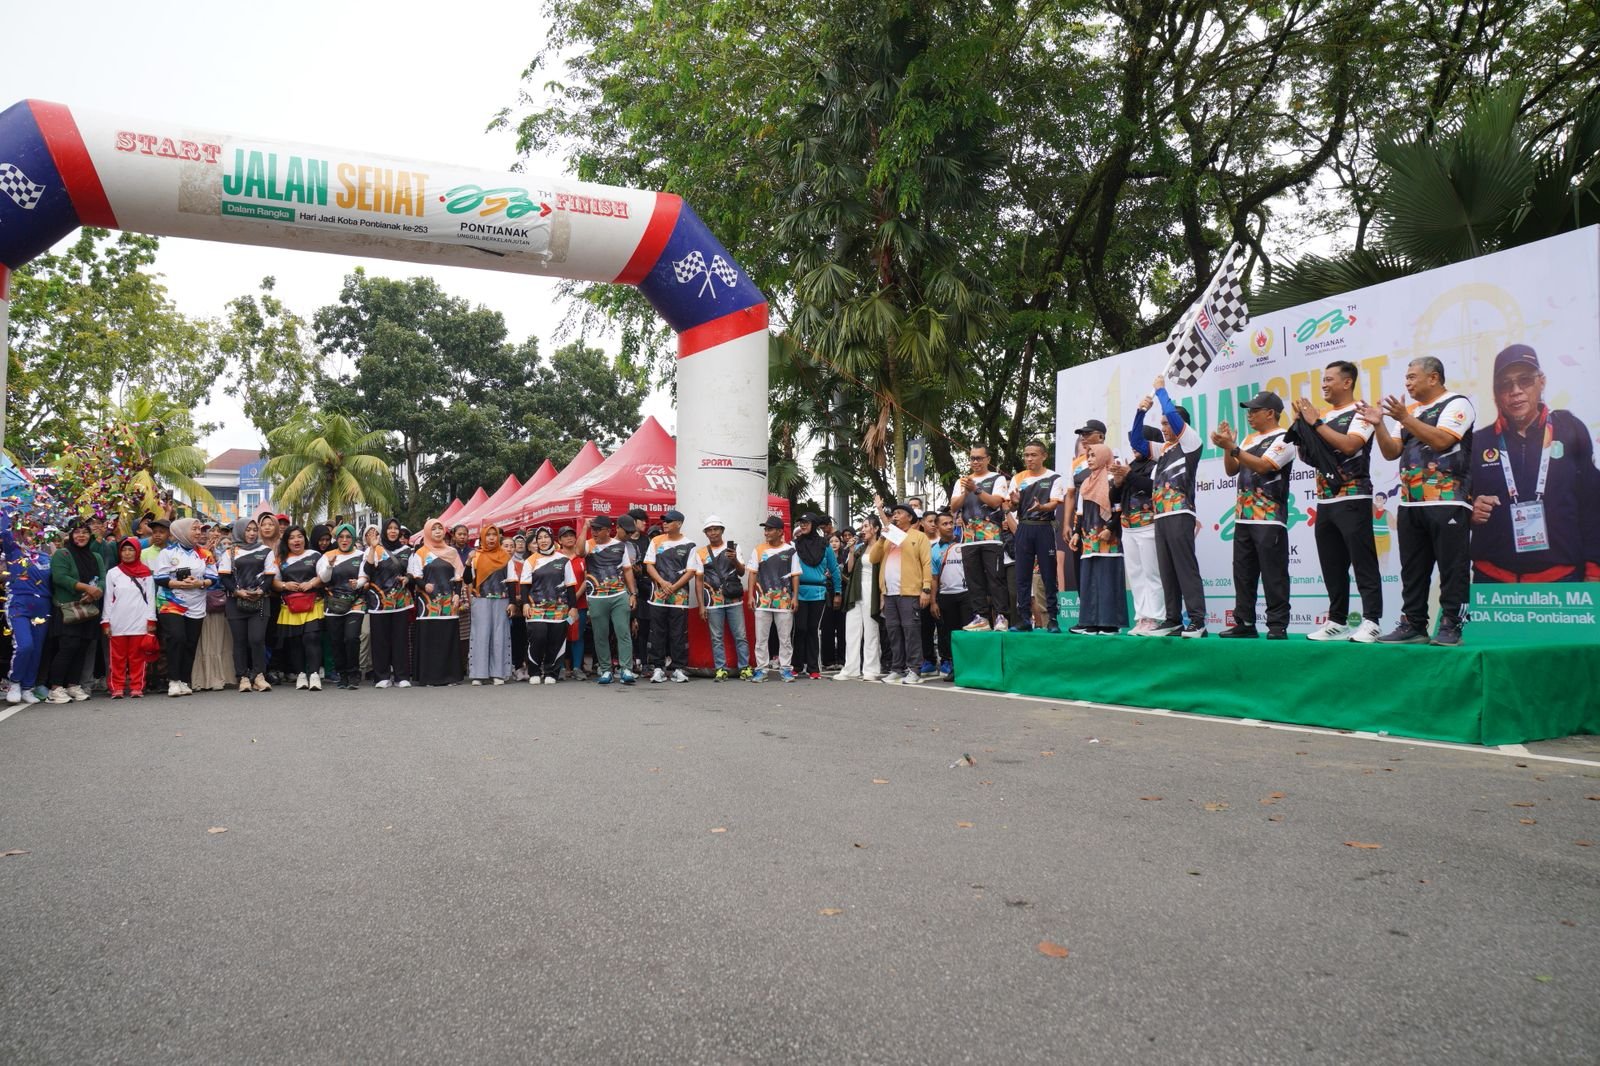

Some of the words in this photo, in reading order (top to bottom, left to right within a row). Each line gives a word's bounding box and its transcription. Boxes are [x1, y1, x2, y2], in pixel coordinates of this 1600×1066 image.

[116, 131, 221, 164] START
[223, 148, 328, 206] JALAN
[336, 163, 430, 217] SEHAT
[537, 190, 552, 198] TH
[227, 204, 255, 215] Dalam
[256, 207, 290, 219] Rangka
[556, 193, 629, 219] FINISH
[300, 212, 316, 221] Hari
[318, 214, 336, 223] Jadi
[337, 216, 358, 226] Kota
[359, 219, 401, 231] Pontianak
[402, 223, 428, 233] ke-253
[457, 233, 481, 241] UNGGUL
[460, 222, 529, 238] PONTIANAK
[1305, 338, 1345, 352] PONTIANAK
[1213, 359, 1245, 373] disporapar
[701, 459, 733, 467] SPORTA
[910, 444, 922, 477] P
[1196, 480, 1215, 492] Hari
[1217, 477, 1237, 490] Jadi
[649, 503, 662, 511] Teh
[1215, 578, 1232, 587] 2024
[1289, 575, 1315, 584] Taman
[1476, 591, 1487, 604] Ir.
[1491, 591, 1562, 608] Amirullah,
[1565, 591, 1594, 605] MA
[1493, 611, 1524, 623] Kota
[1527, 612, 1596, 624] Pontianak
